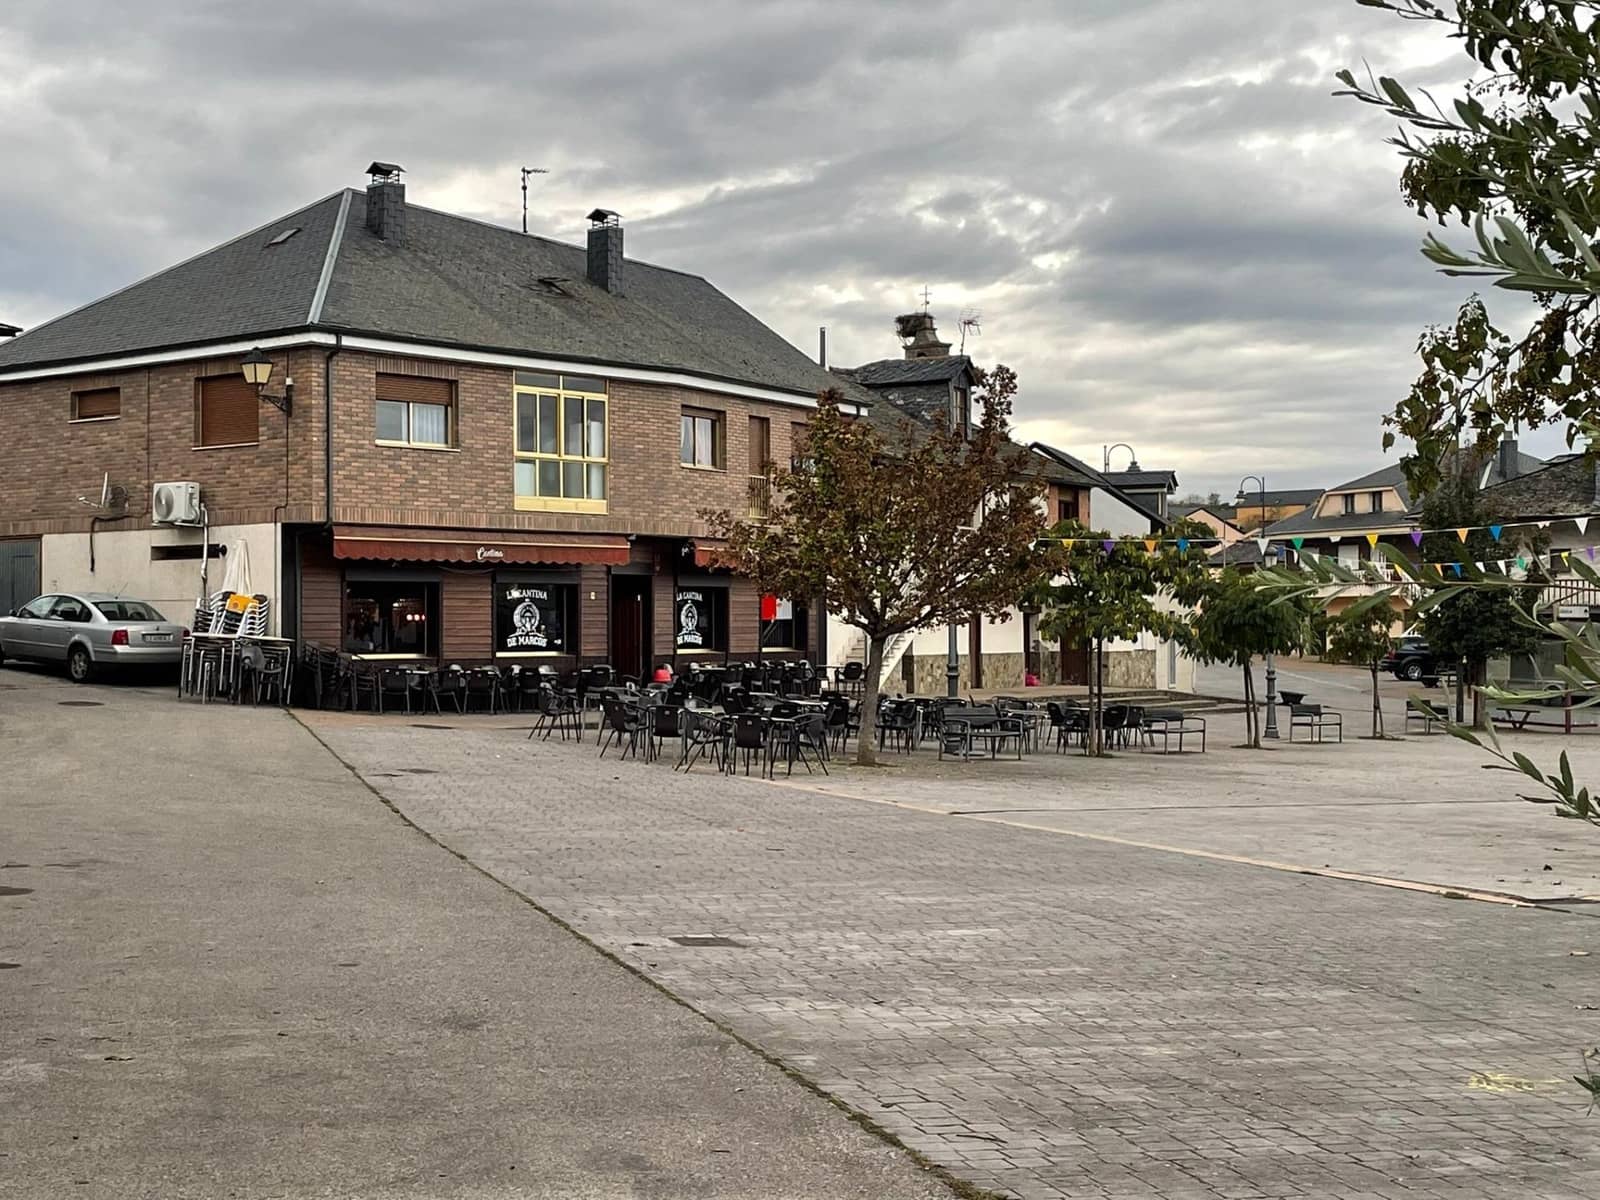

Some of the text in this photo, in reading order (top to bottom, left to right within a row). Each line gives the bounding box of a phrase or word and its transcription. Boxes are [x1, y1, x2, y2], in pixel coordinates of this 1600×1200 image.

[516, 589, 548, 600] CANTINA
[507, 636, 548, 647] DE MARCOS
